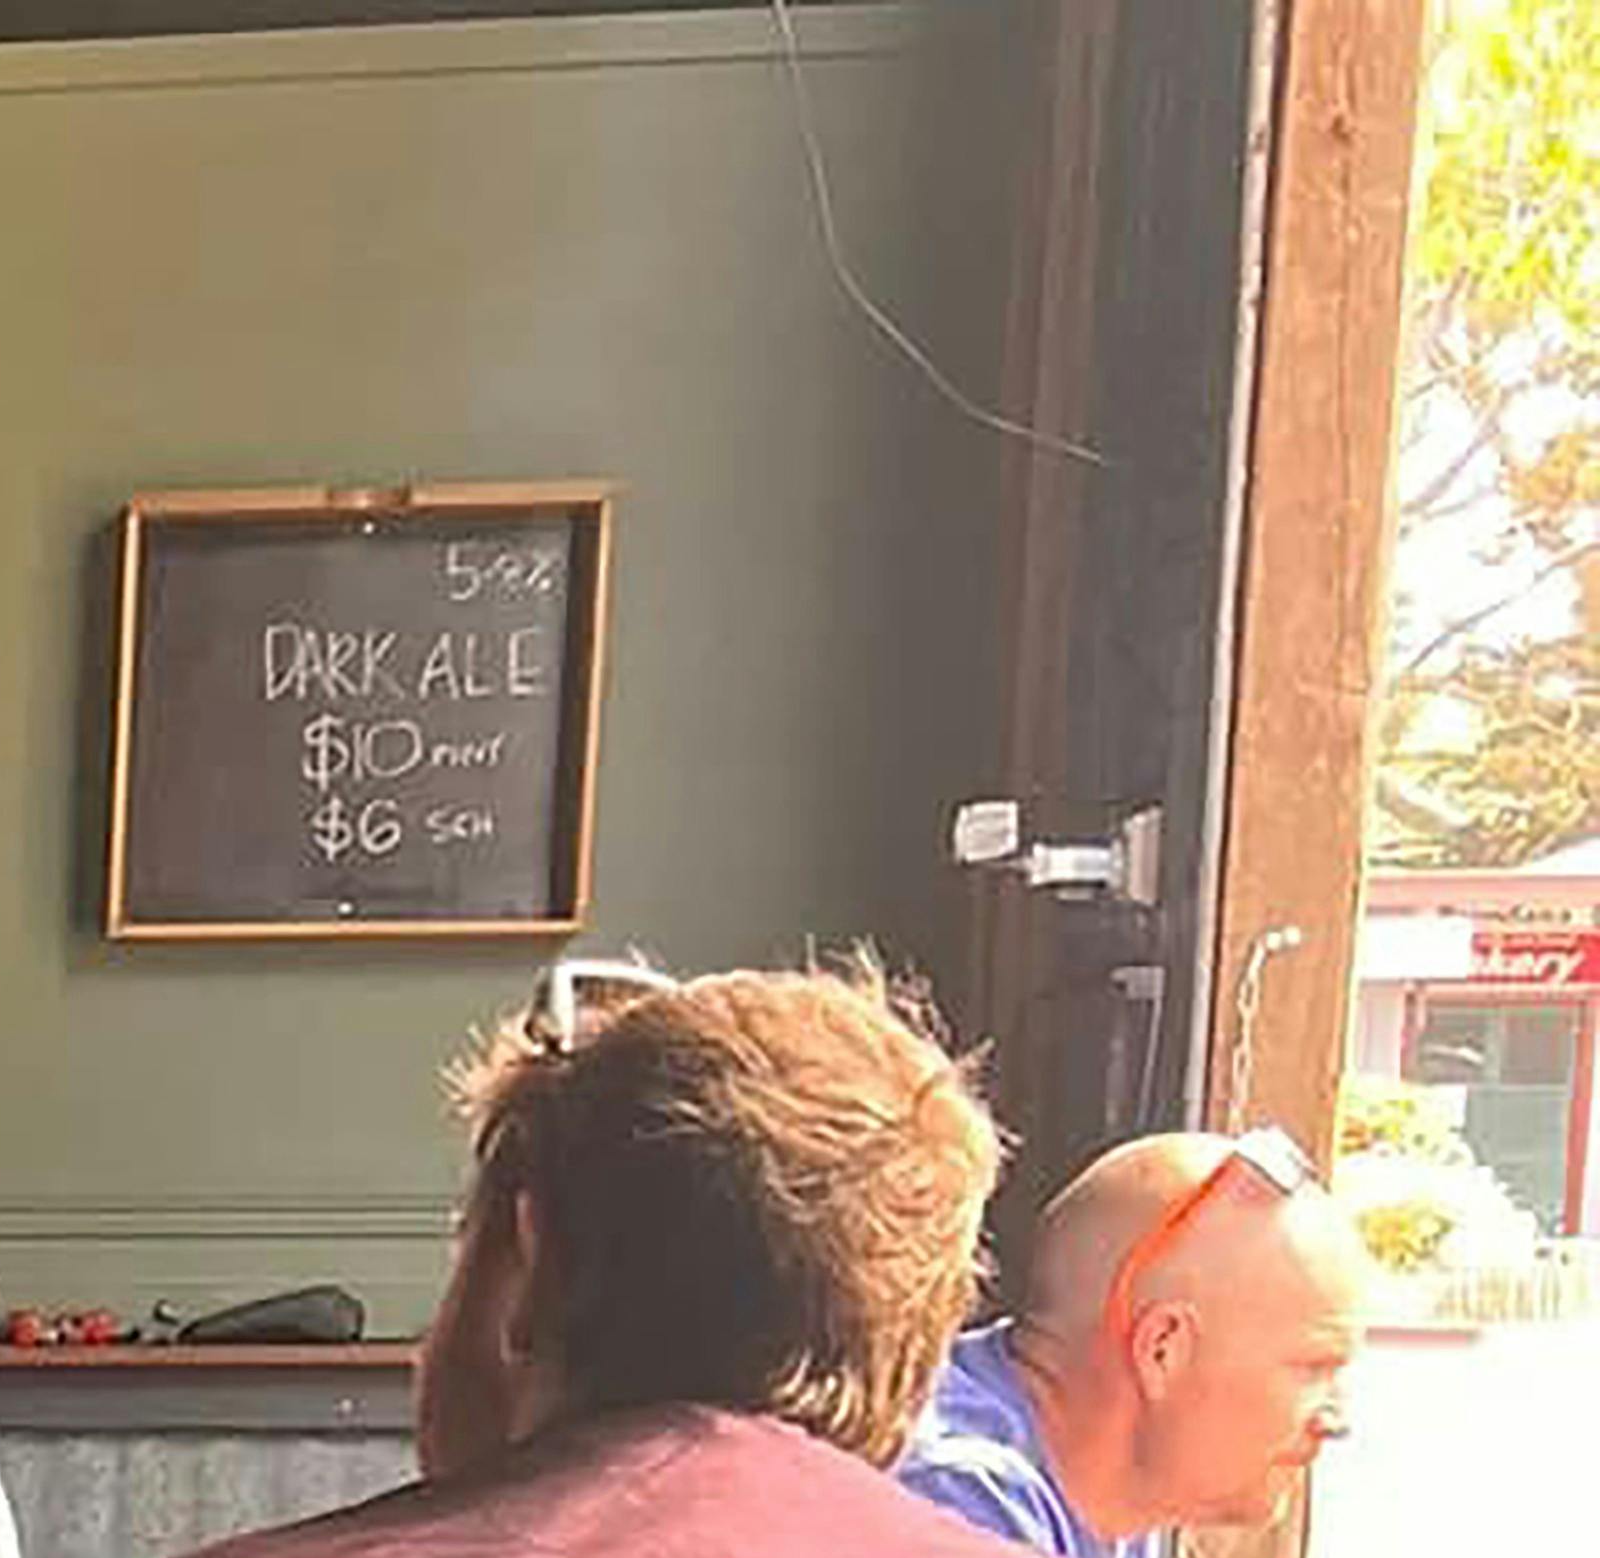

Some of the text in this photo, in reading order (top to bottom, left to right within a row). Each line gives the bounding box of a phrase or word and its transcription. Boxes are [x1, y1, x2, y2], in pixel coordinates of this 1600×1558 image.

[263, 623, 546, 701] DARK ALE
[302, 713, 423, 791] $10
[311, 796, 401, 862] $6
